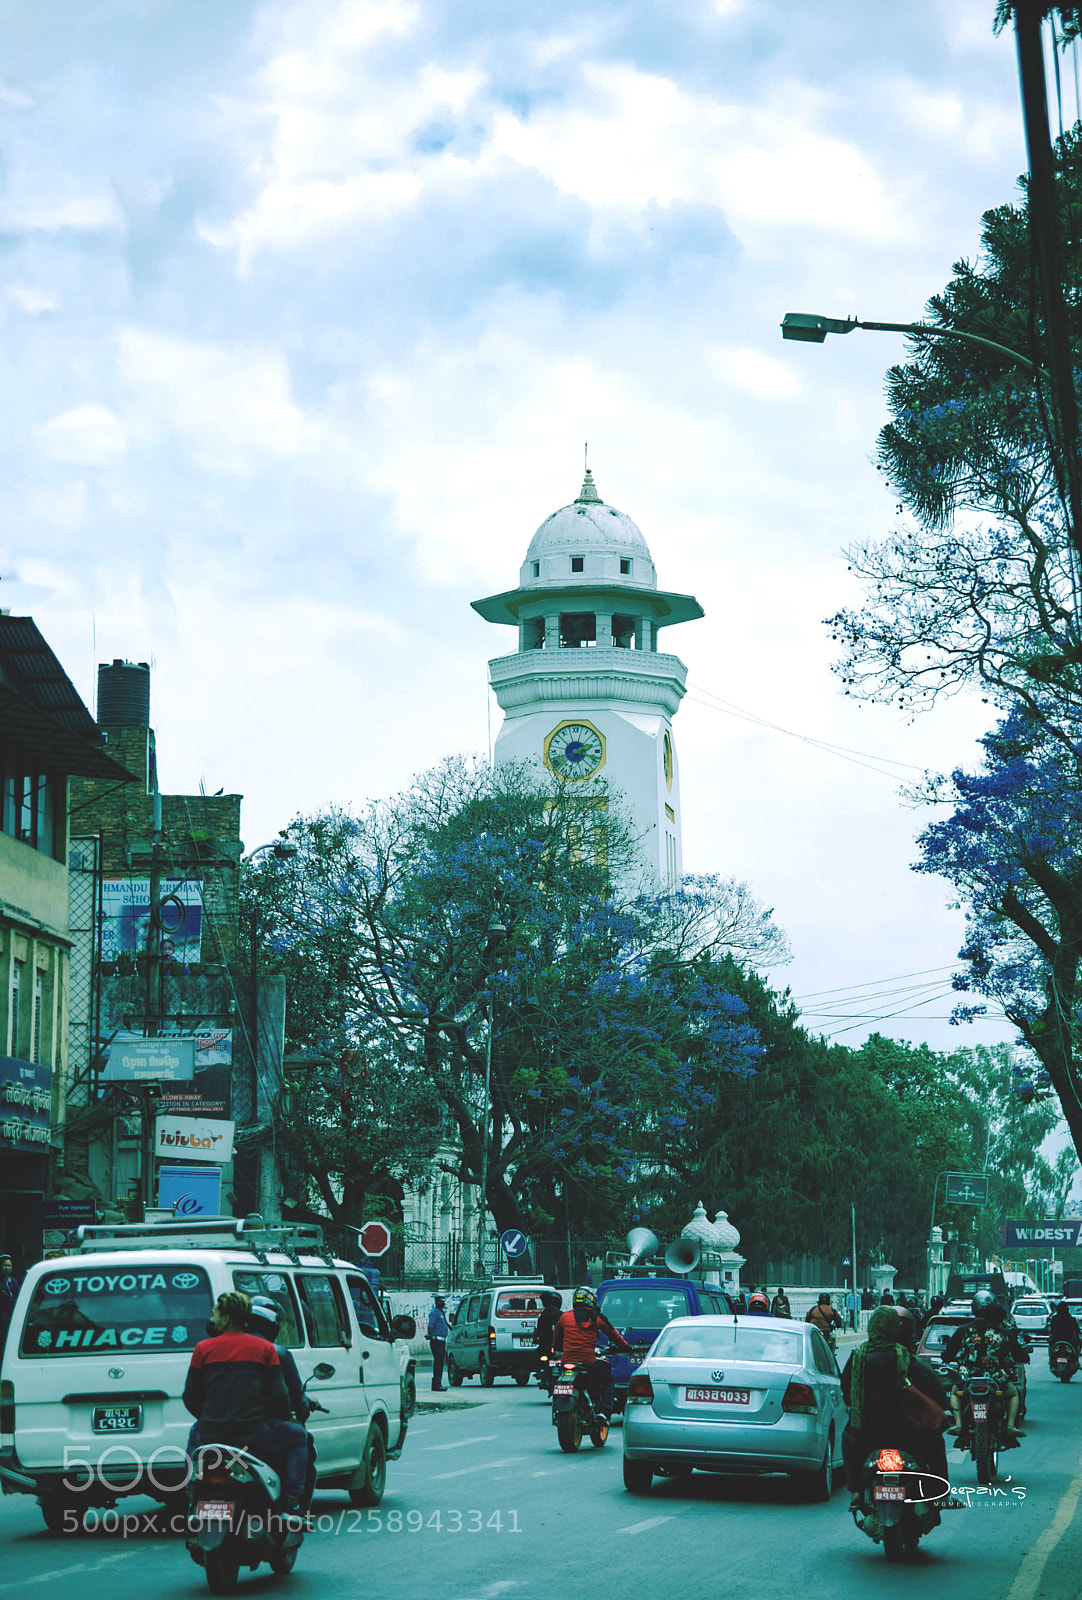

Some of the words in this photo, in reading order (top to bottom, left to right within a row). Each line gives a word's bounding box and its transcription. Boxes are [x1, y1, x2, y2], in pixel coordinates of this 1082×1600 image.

[103, 883, 148, 893] HMANDU
[159, 883, 200, 893] ERIDIAN
[122, 895, 150, 904] SCHO
[1015, 1228, 1074, 1240] WIDEST
[73, 1273, 168, 1293] TOYOTA
[55, 1327, 168, 1348] HIACE
